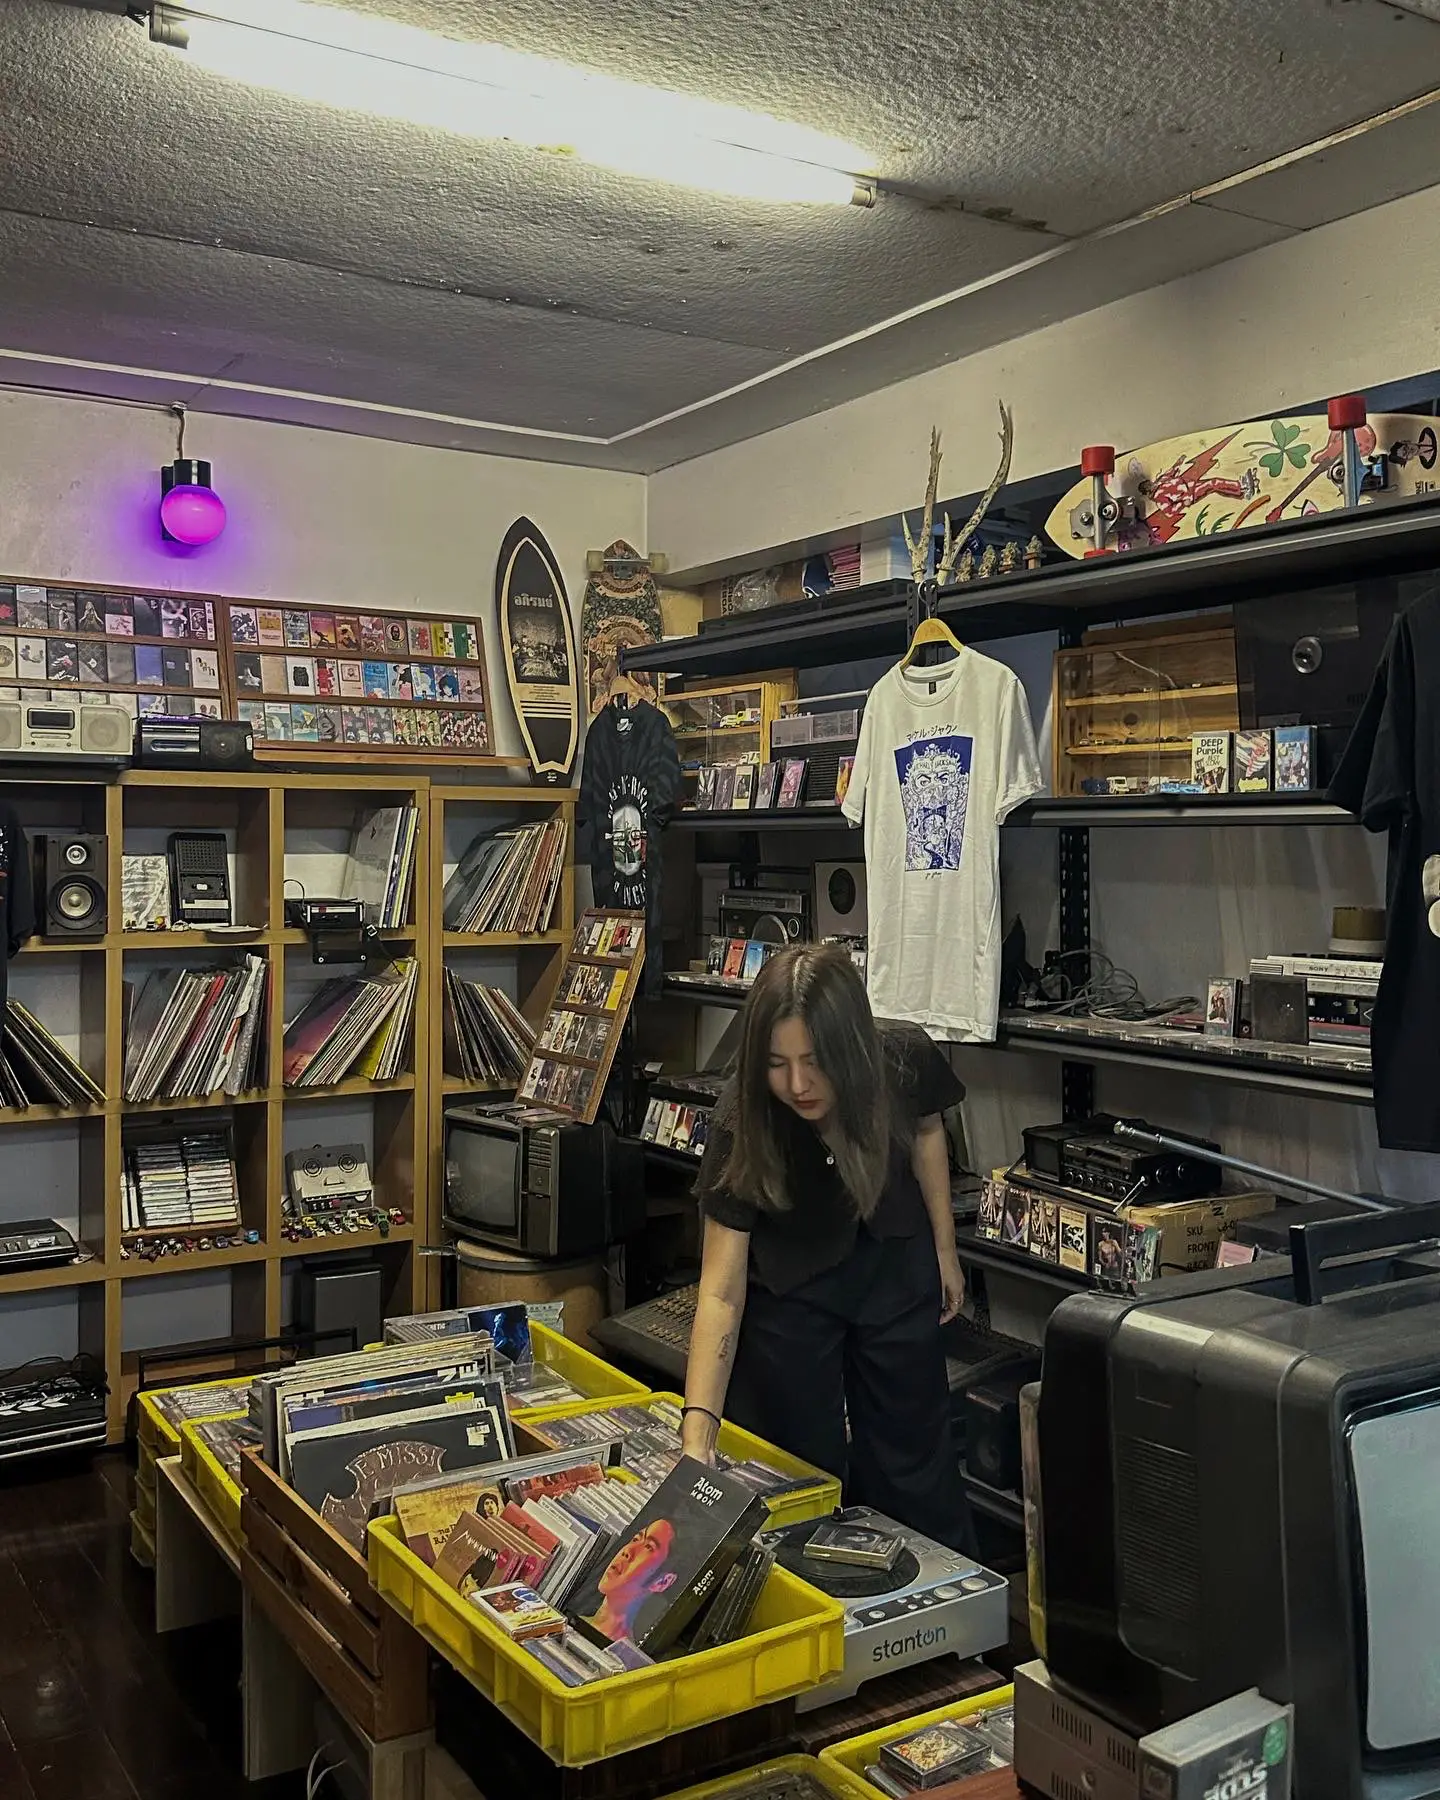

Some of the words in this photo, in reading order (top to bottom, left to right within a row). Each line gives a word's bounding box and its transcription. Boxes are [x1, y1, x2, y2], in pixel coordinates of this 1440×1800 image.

[1201, 738, 1223, 748] DEEP
[1186, 1226, 1203, 1237] SKU
[1187, 1241, 1216, 1254] FRONT
[693, 1476, 724, 1501] Atom
[692, 1569, 714, 1595] Atom
[872, 1625, 947, 1662] stanton
